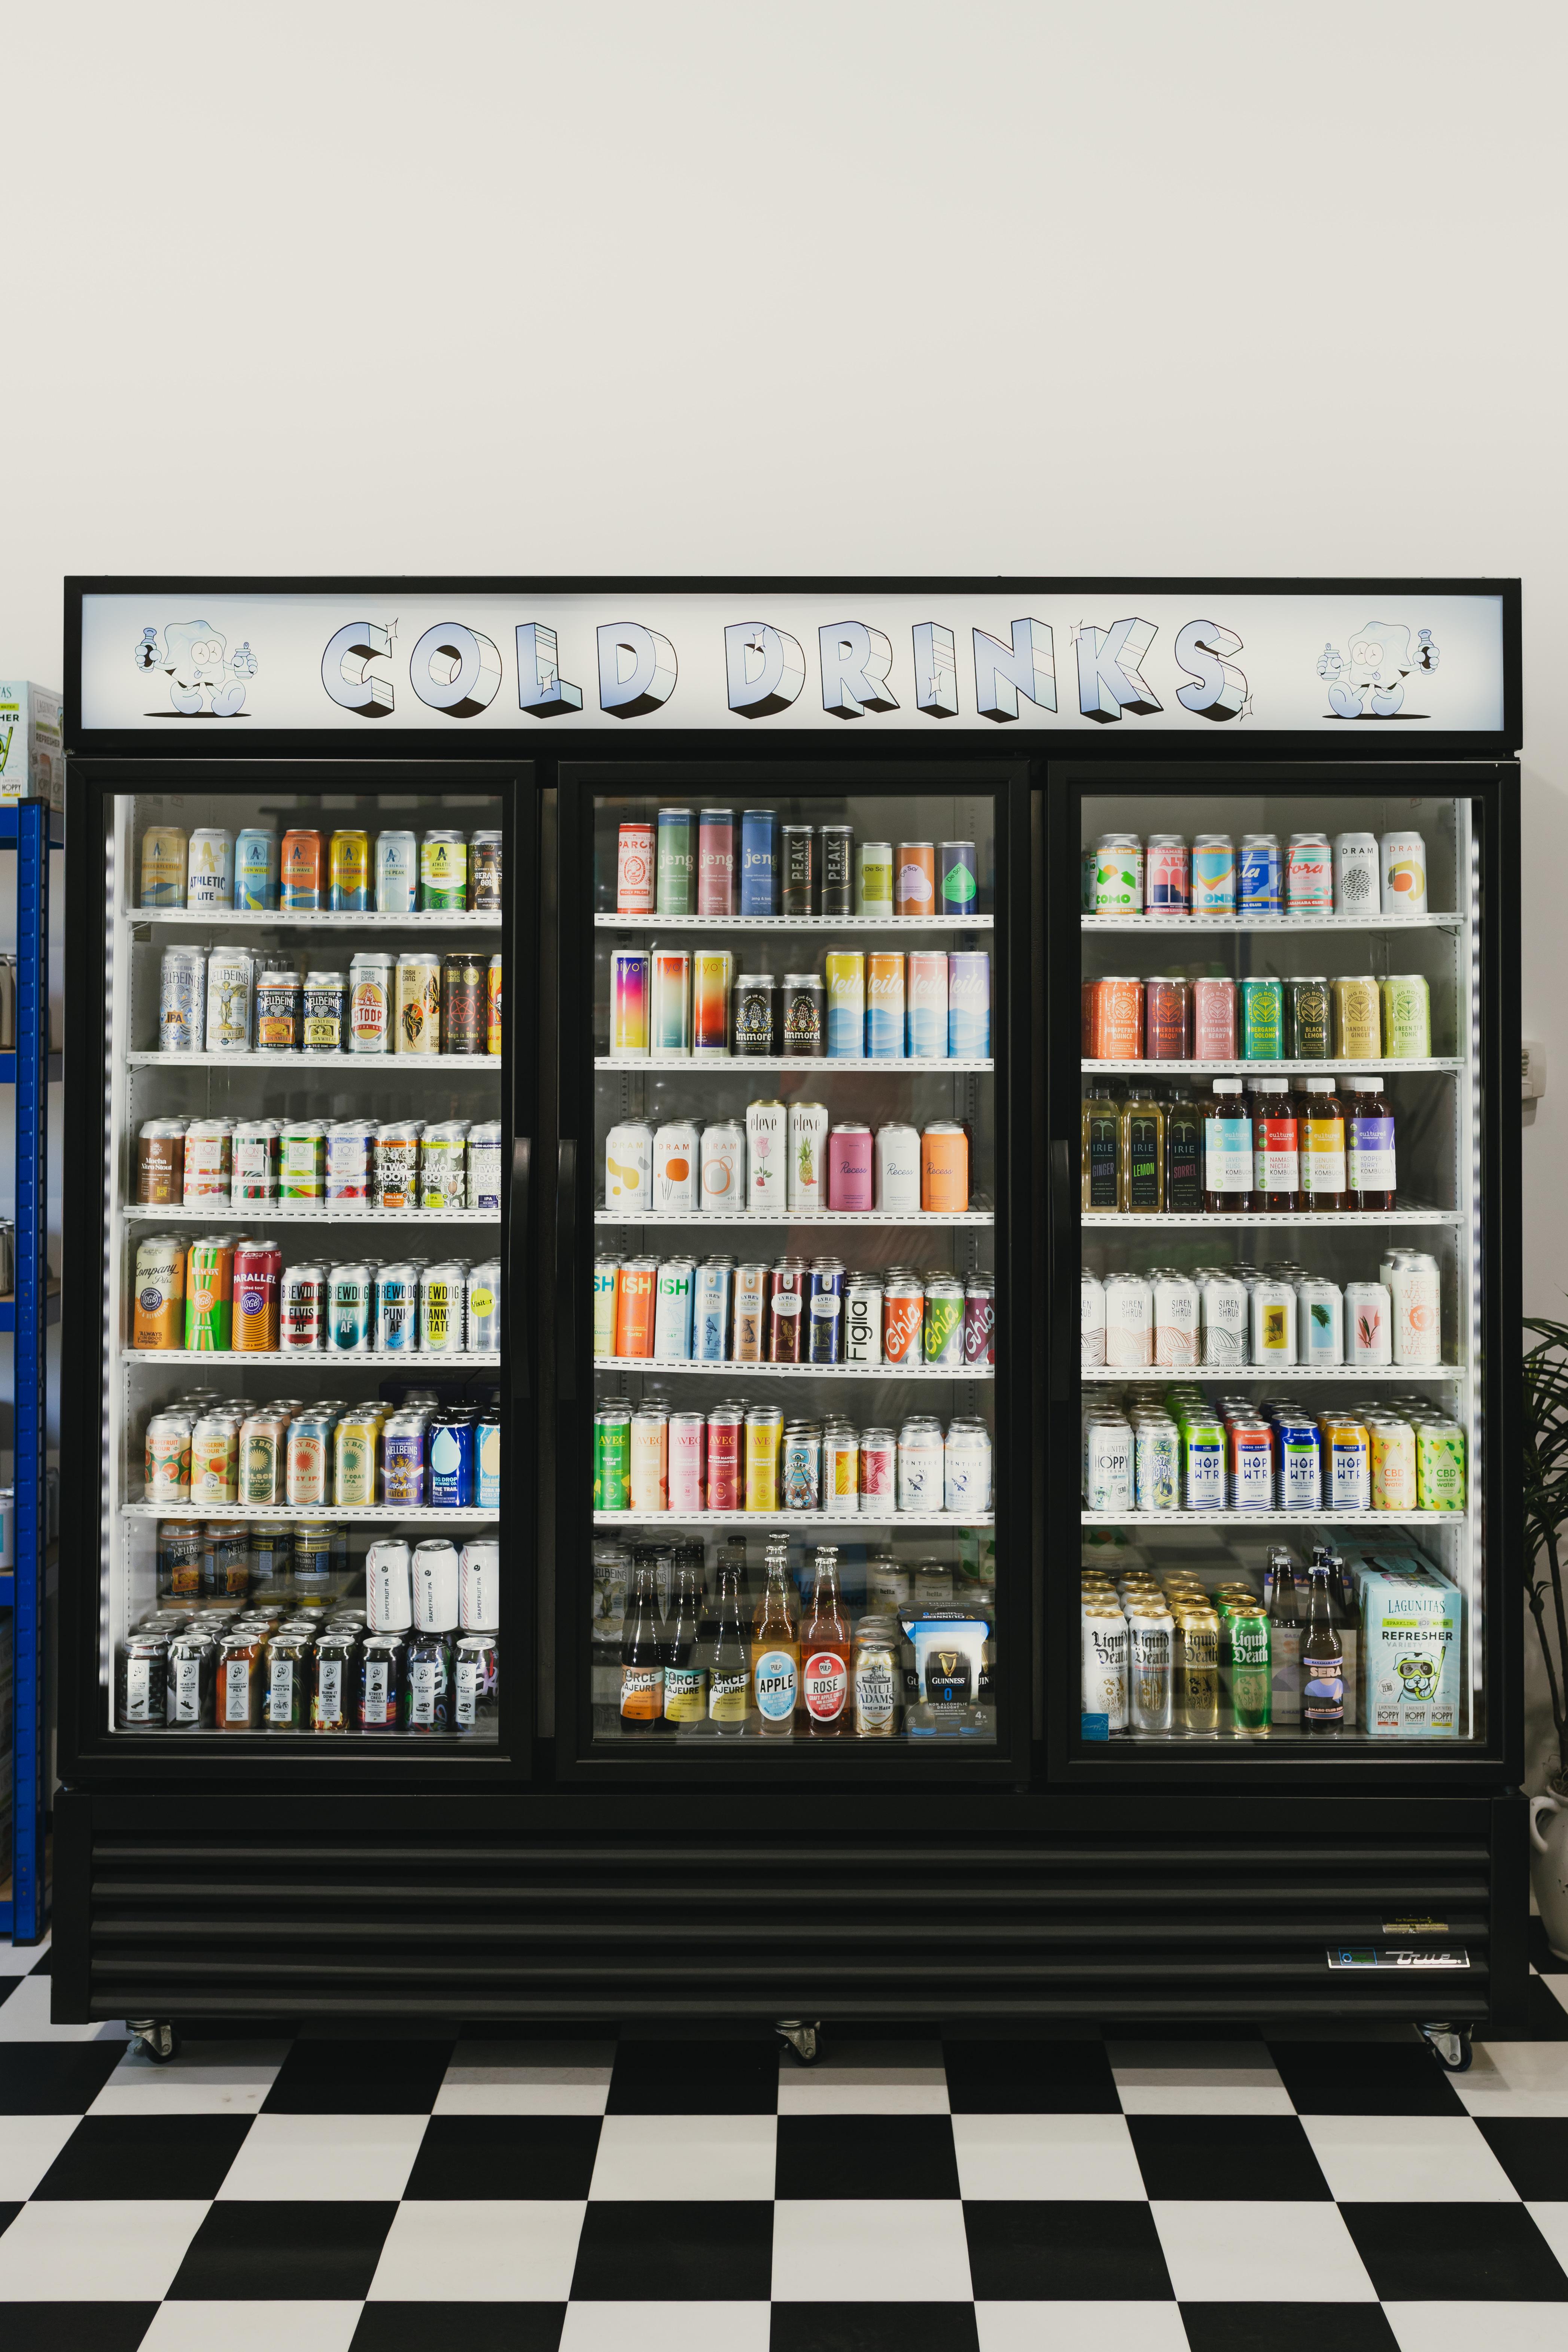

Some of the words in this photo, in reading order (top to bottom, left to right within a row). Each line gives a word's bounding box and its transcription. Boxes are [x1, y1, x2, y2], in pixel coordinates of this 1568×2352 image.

[321, 621, 678, 719] COLD
[724, 617, 1250, 724] DRINKS
[619, 840, 654, 854] PARCH
[660, 849, 694, 871] jeng
[700, 849, 734, 871] jeng
[792, 841, 804, 879] PEAK
[828, 841, 840, 880] PEAK
[1160, 856, 1188, 867] ALTA
[190, 876, 226, 890] ATHLETIC
[198, 892, 214, 900] LITE
[1097, 894, 1130, 904] COMO
[1203, 893, 1236, 903] ONDA
[868, 973, 903, 994] leilo
[949, 973, 984, 994] leilo
[306, 997, 339, 1011] WELLBEING
[742, 995, 751, 1004] SLOW
[759, 995, 767, 1004] ROLL
[167, 1014, 182, 1023] IPA
[354, 1008, 382, 1023] STOOP
[736, 1031, 774, 1041] Immorel
[785, 1030, 820, 1039] Immorel
[751, 1114, 777, 1131] élevé
[293, 1146, 309, 1154] NON
[382, 1163, 408, 1171] TWO
[840, 1161, 868, 1174] Recess
[887, 1163, 914, 1175] Recess
[1092, 1162, 1114, 1177] GINGER
[1133, 1162, 1154, 1177] LEMON
[1173, 1164, 1197, 1179] SORREL
[378, 1172, 412, 1181] ROOTS
[136, 1262, 179, 1278] Company
[234, 1273, 276, 1284] PARALLEL
[1410, 1281, 1434, 1289] HOP
[328, 1286, 368, 1300] BREWDOG
[1401, 1289, 1440, 1298] WATER
[1172, 1300, 1191, 1309] SIREN
[1219, 1300, 1239, 1309] SIREN
[289, 1308, 313, 1319] ELVIS
[337, 1309, 359, 1320] HAZY
[384, 1308, 409, 1320] PUNK
[1172, 1308, 1191, 1317] SHRUB
[1219, 1308, 1239, 1317] SHRUB
[295, 1321, 307, 1332] AF
[424, 1321, 450, 1332] STATE
[846, 1301, 873, 1360] Figlia
[886, 1303, 920, 1354] Ghia
[925, 1304, 959, 1354] Ghia
[1401, 1345, 1440, 1354] WATER
[599, 1436, 625, 1444] AVEC
[709, 1436, 735, 1444] AVEC
[386, 1446, 417, 1455] WELLBEING
[1095, 1456, 1129, 1469] HOPPY
[1195, 1470, 1219, 1479] WTR
[1244, 1470, 1267, 1479] WTR
[1388, 1600, 1445, 1613] LAGUNITAS
[1229, 1628, 1267, 1650] Liquid
[1382, 1631, 1453, 1640] REFRESHER
[1233, 1647, 1268, 1663] Death
[1310, 1666, 1341, 1677] SERA
[760, 1674, 793, 1693] APPLE
[813, 1676, 838, 1693] ROSÉ
[856, 1680, 897, 1693] SAMUEL
[859, 1693, 895, 1704] ADAMS
